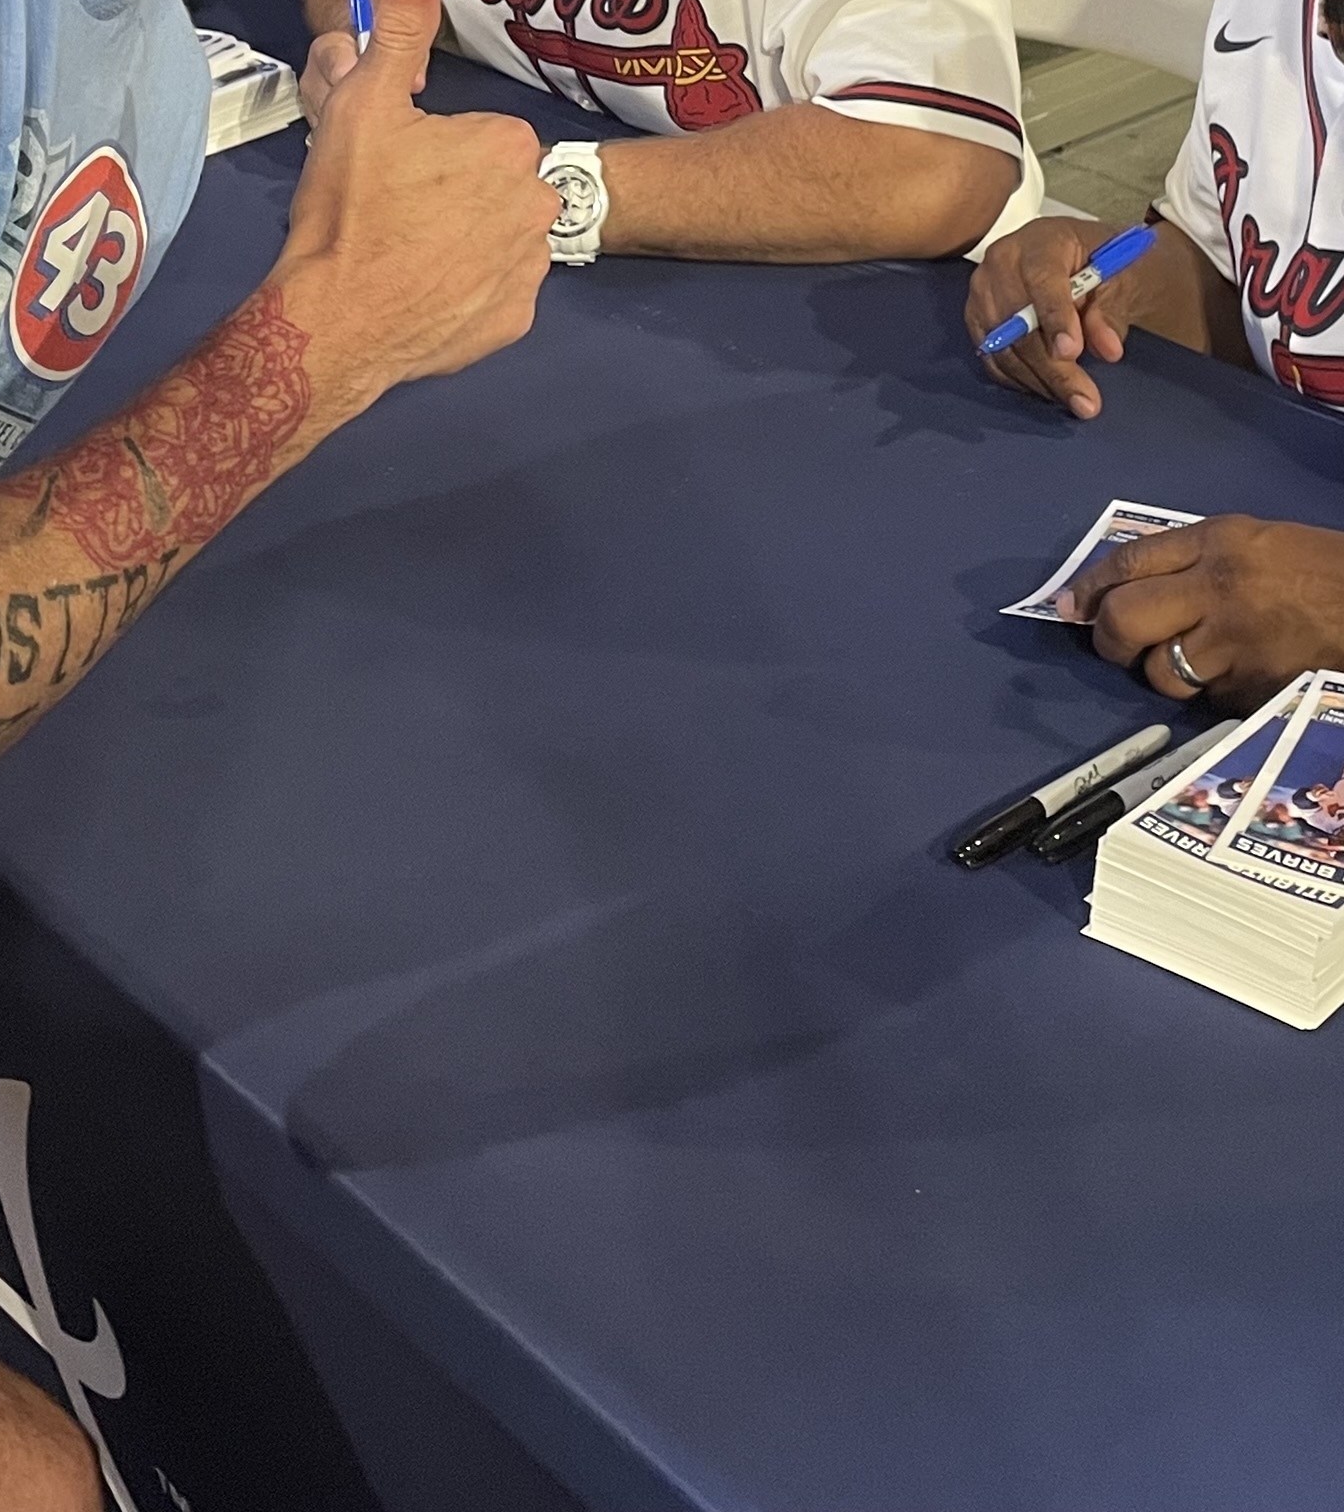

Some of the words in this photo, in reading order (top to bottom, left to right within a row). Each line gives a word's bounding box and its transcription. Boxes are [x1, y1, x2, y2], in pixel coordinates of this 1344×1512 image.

[42, 191, 138, 337] 43
[1139, 814, 1209, 858] RAVES
[1235, 838, 1340, 880] BRAVES
